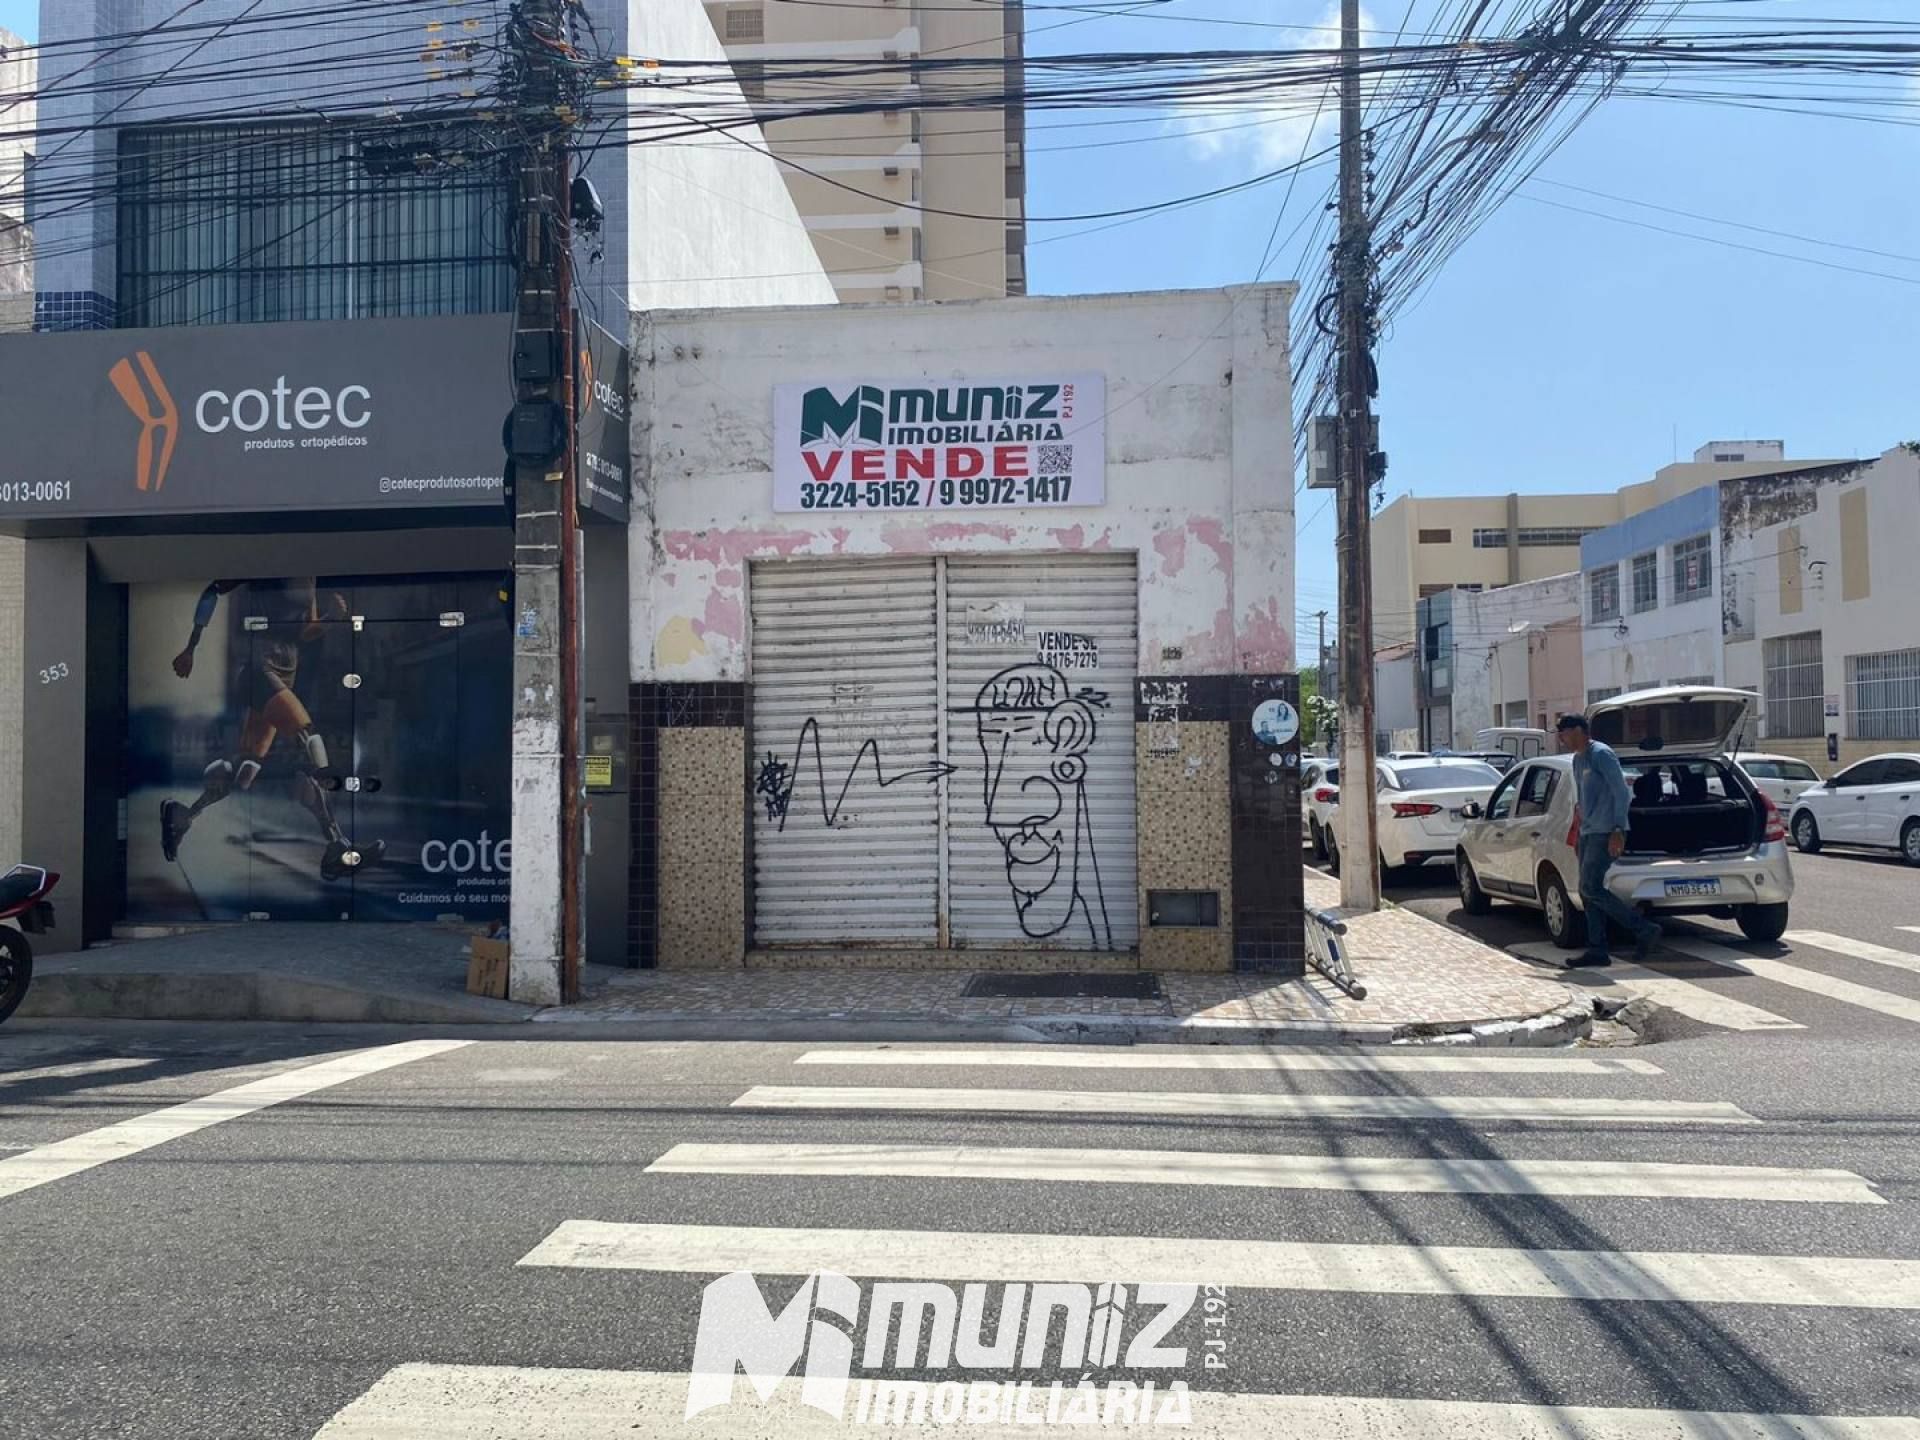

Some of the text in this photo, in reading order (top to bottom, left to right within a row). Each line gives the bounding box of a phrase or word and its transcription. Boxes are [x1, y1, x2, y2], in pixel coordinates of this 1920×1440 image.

[196, 375, 371, 432] cotec
[594, 380, 625, 413] cotec
[244, 435, 368, 451] produtos ortopédicos
[801, 446, 1029, 481] VENDE
[0, 480, 71, 502] 013-0061
[801, 476, 1072, 509] 3224-5152 / 9 9972-1417
[40, 662, 69, 684] 353
[420, 829, 512, 873] cote
[398, 892, 452, 904] Cuidamos
[469, 894, 489, 903] seu
